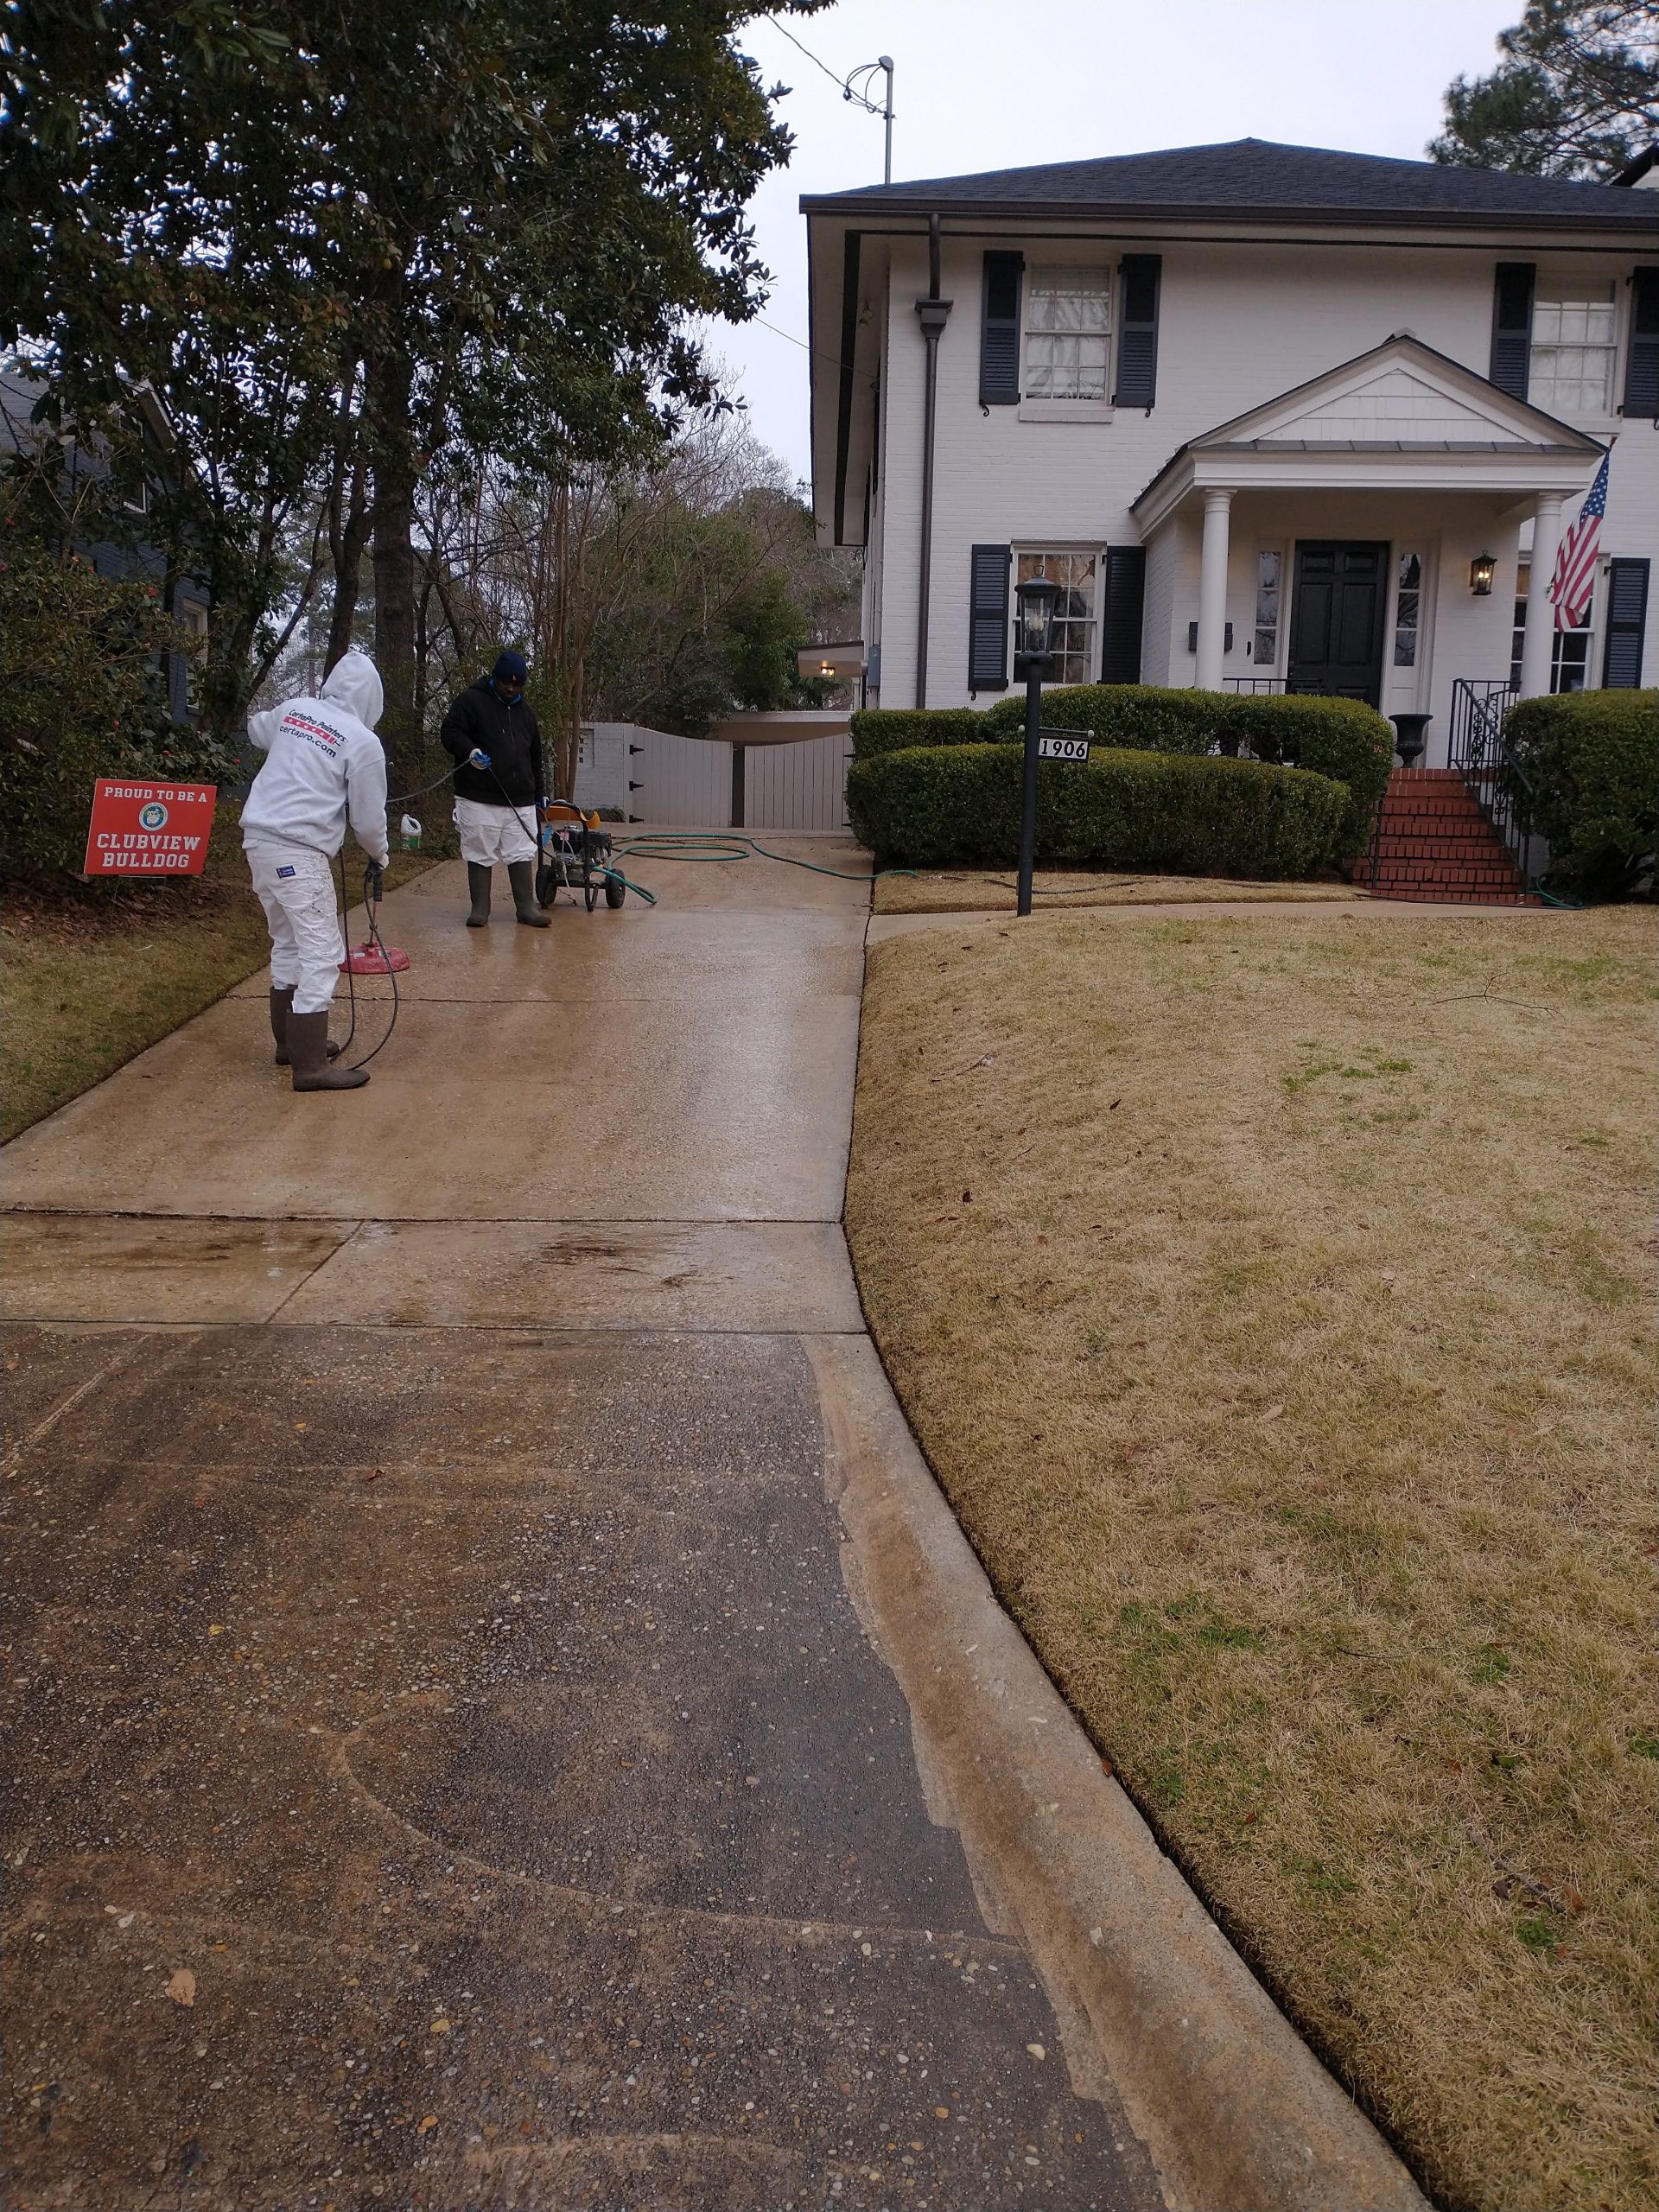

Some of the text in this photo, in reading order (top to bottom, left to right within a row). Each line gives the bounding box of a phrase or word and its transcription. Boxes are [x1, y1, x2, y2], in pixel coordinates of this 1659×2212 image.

[289, 709, 346, 742] CertaPro Painters
[279, 725, 337, 758] certapro.com
[1041, 740, 1085, 758] 1906
[104, 786, 207, 803] PROUD TO BE A
[97, 833, 201, 851] CLUBVIEW
[102, 852, 190, 868] BULLDOG
